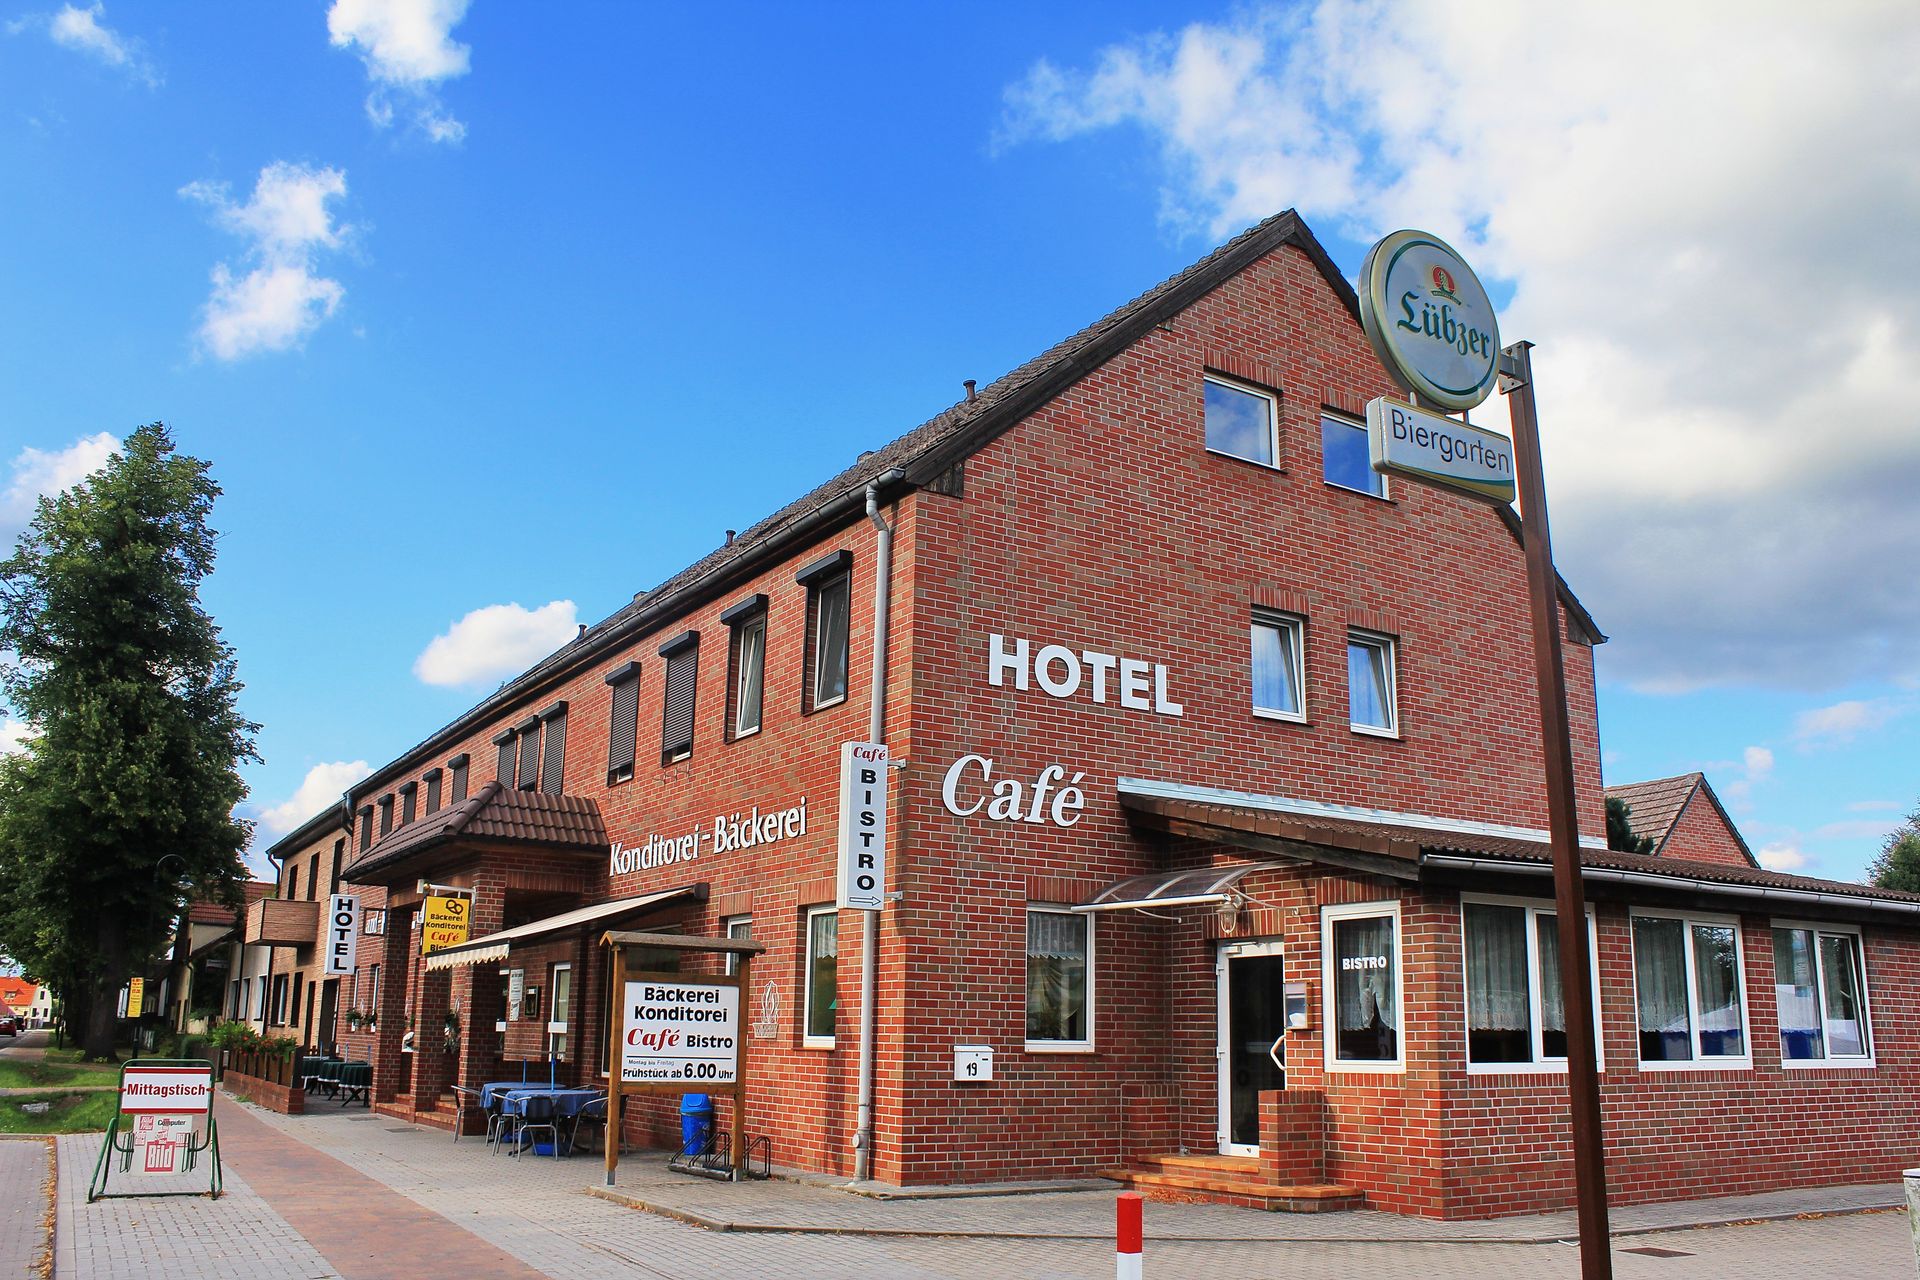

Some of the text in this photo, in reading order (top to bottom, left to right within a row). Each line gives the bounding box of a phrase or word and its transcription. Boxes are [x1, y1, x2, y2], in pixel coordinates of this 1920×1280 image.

[1397, 290, 1489, 359] Lübzer
[1391, 408, 1509, 474] Biergarten
[988, 633, 1183, 717] HOTEL
[853, 746, 886, 763] Café
[942, 754, 1086, 828] Café
[856, 769, 877, 891] BISTRO
[334, 898, 353, 970] HOTEL
[426, 921, 466, 931] Konditorei
[431, 931, 459, 943] Café
[1342, 955, 1387, 970] BISTRO
[644, 986, 719, 1003] Bäckerei
[634, 1005, 728, 1022] Konditorei
[627, 1028, 733, 1051] Café Bistro
[622, 1062, 734, 1079] Frühstück ab 6.00 Uhr
[966, 1062, 978, 1077] 19
[127, 1084, 205, 1097] Mittagstisch
[147, 1144, 174, 1168] Bild
